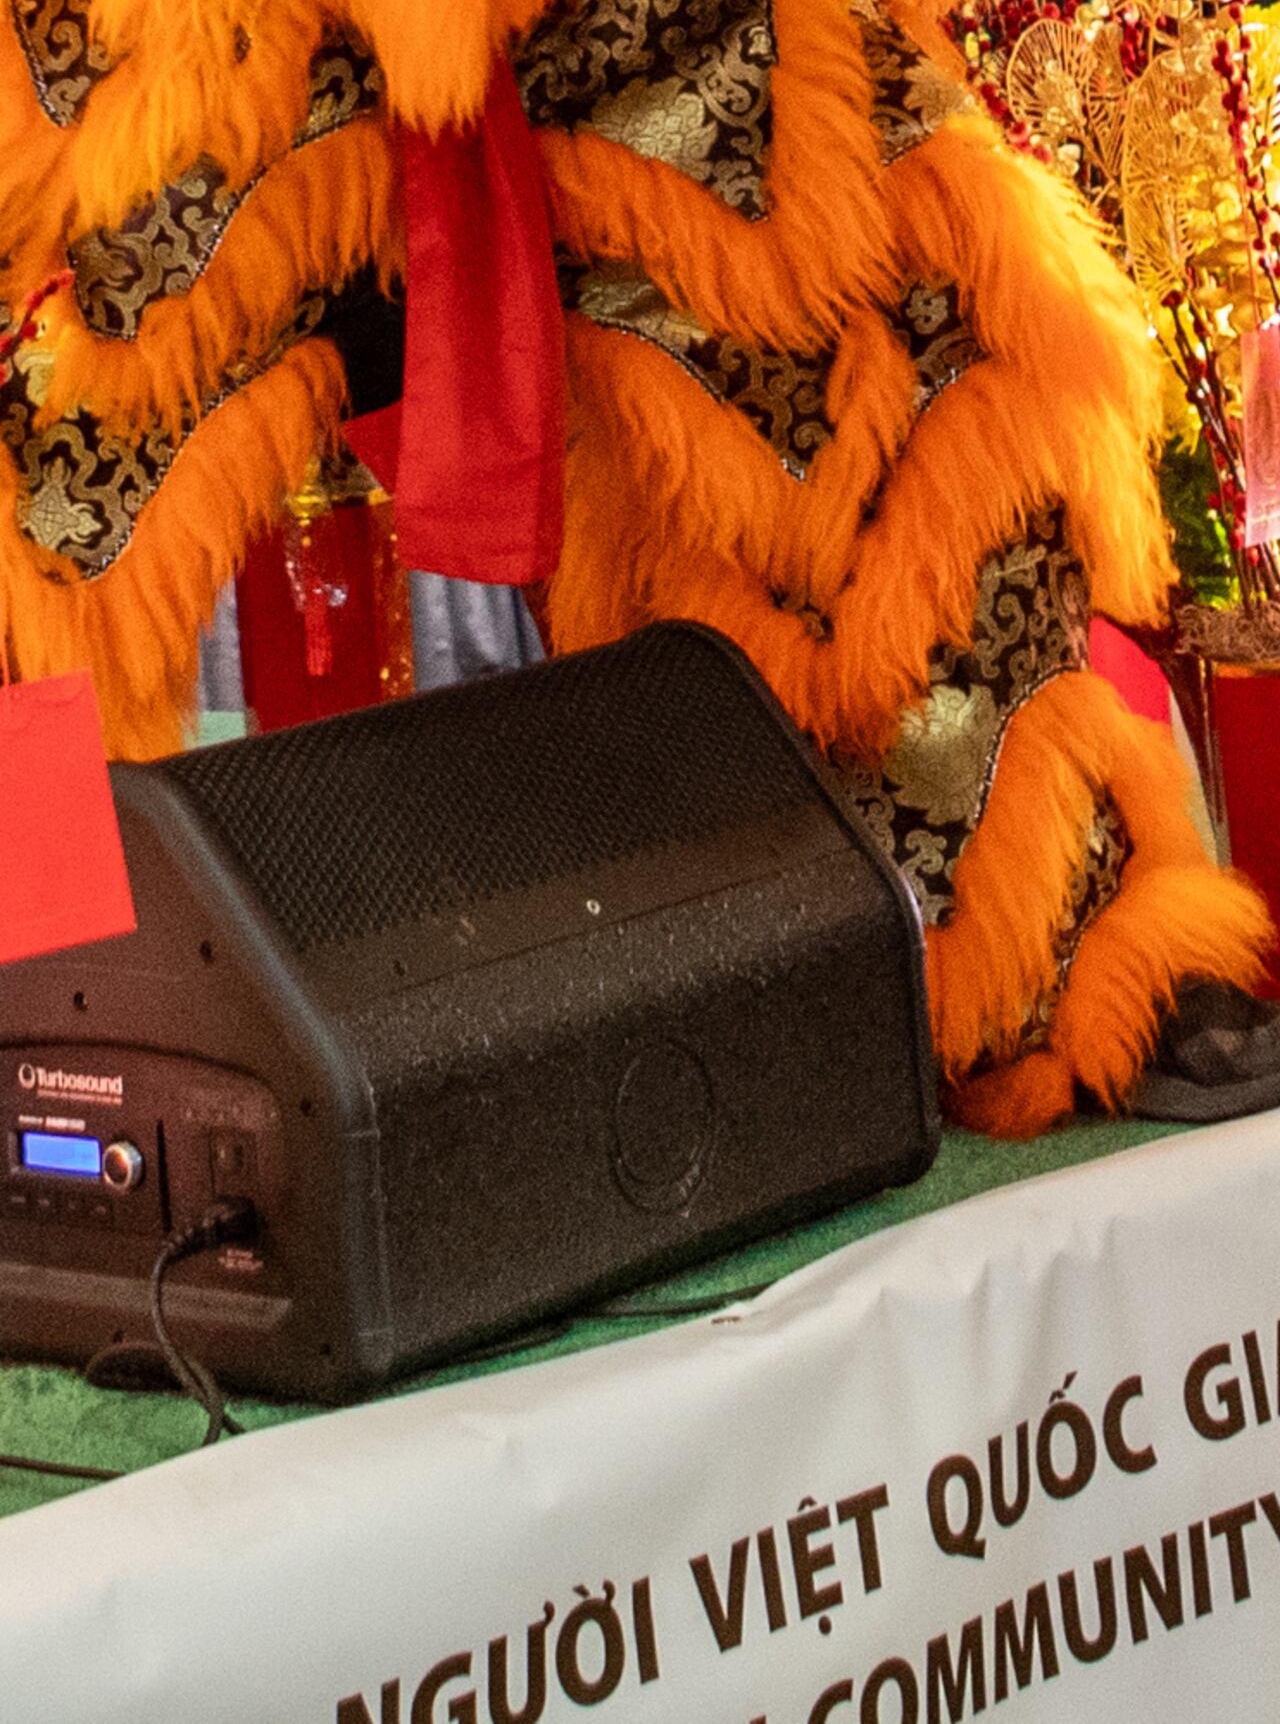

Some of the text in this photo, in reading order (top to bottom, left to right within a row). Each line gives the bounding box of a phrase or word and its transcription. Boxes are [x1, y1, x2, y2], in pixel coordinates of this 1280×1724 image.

[35, 1066, 123, 1096] Turbosound
[689, 1482, 889, 1654] VIỆT
[926, 1371, 1157, 1559] QUỐC
